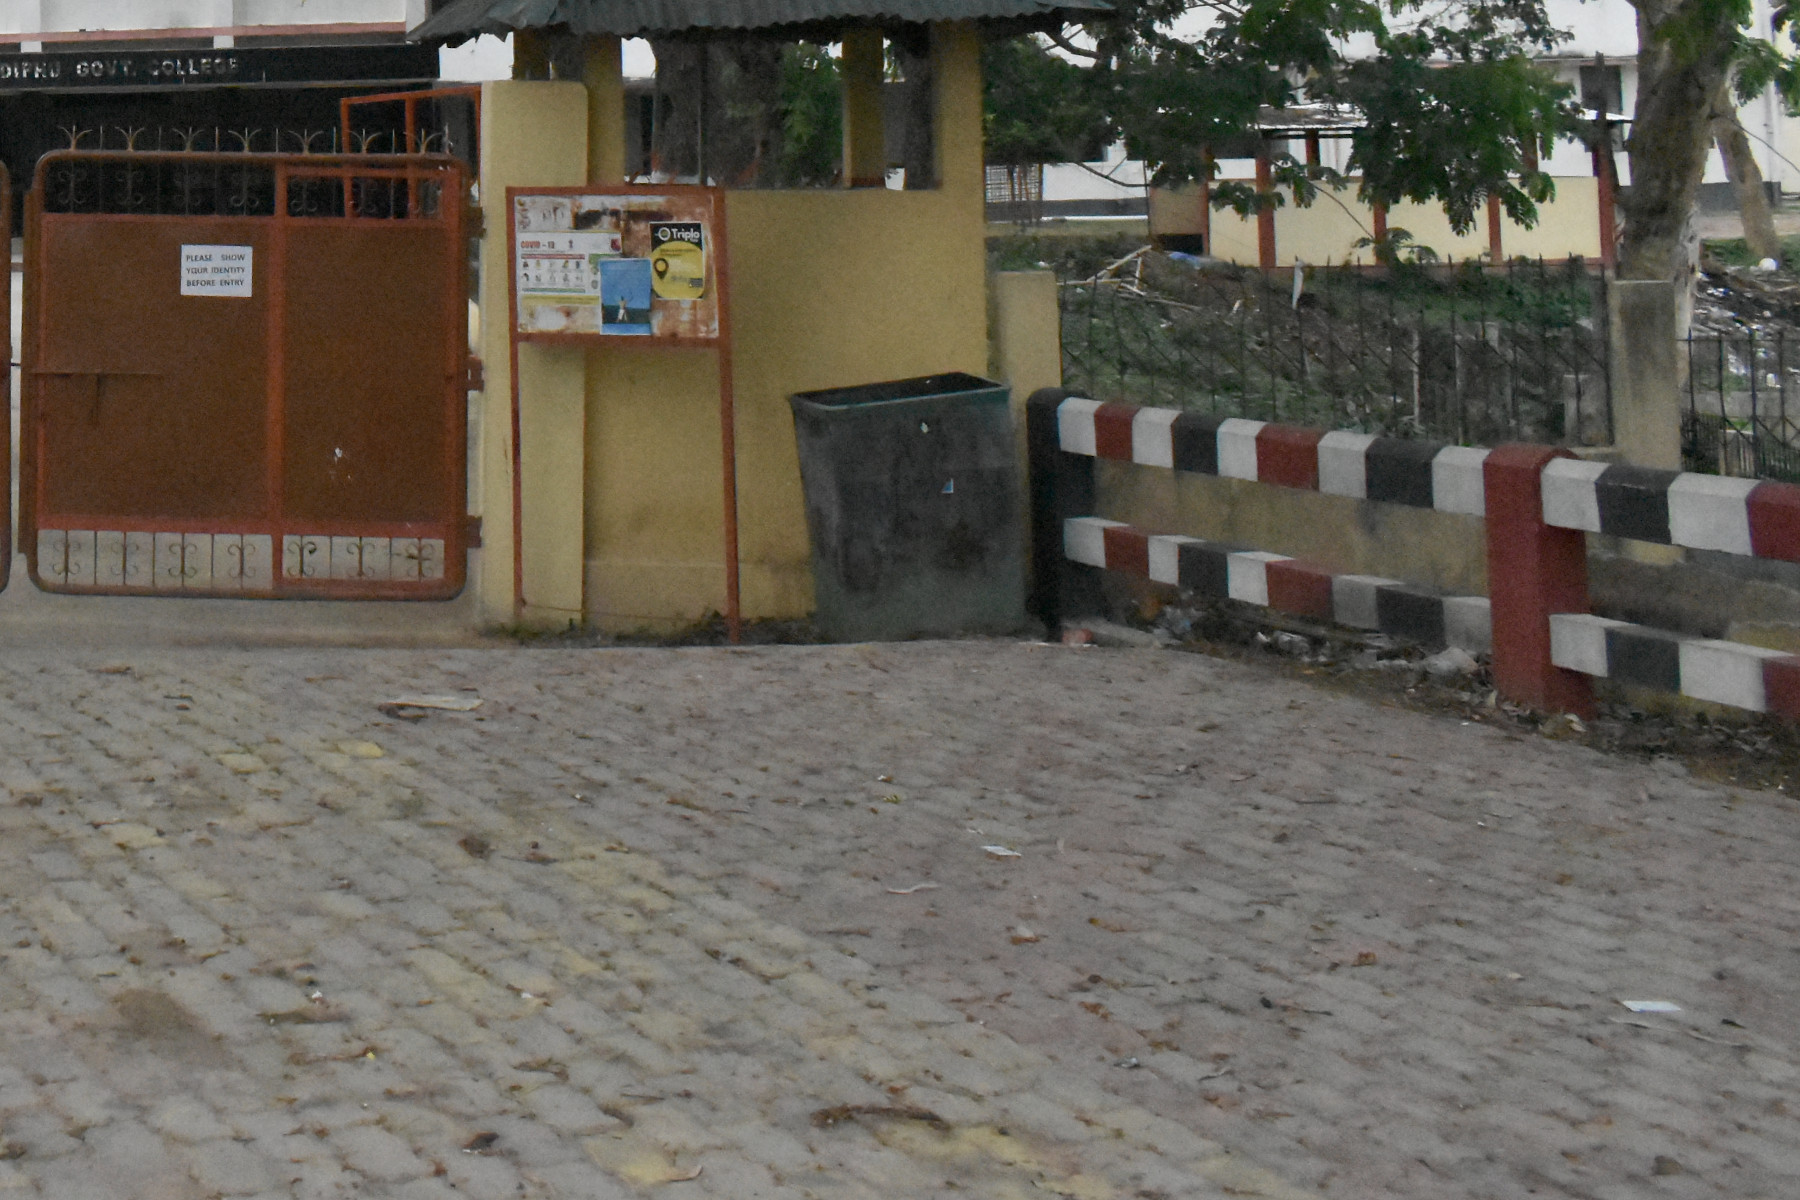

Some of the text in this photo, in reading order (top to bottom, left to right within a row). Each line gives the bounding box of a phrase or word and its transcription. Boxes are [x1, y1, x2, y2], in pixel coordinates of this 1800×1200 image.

[0, 60, 61, 79] DIPHU
[520, 240, 541, 248] COVID
[186, 254, 213, 262] PLEASE
[186, 267, 208, 275] YOUR
